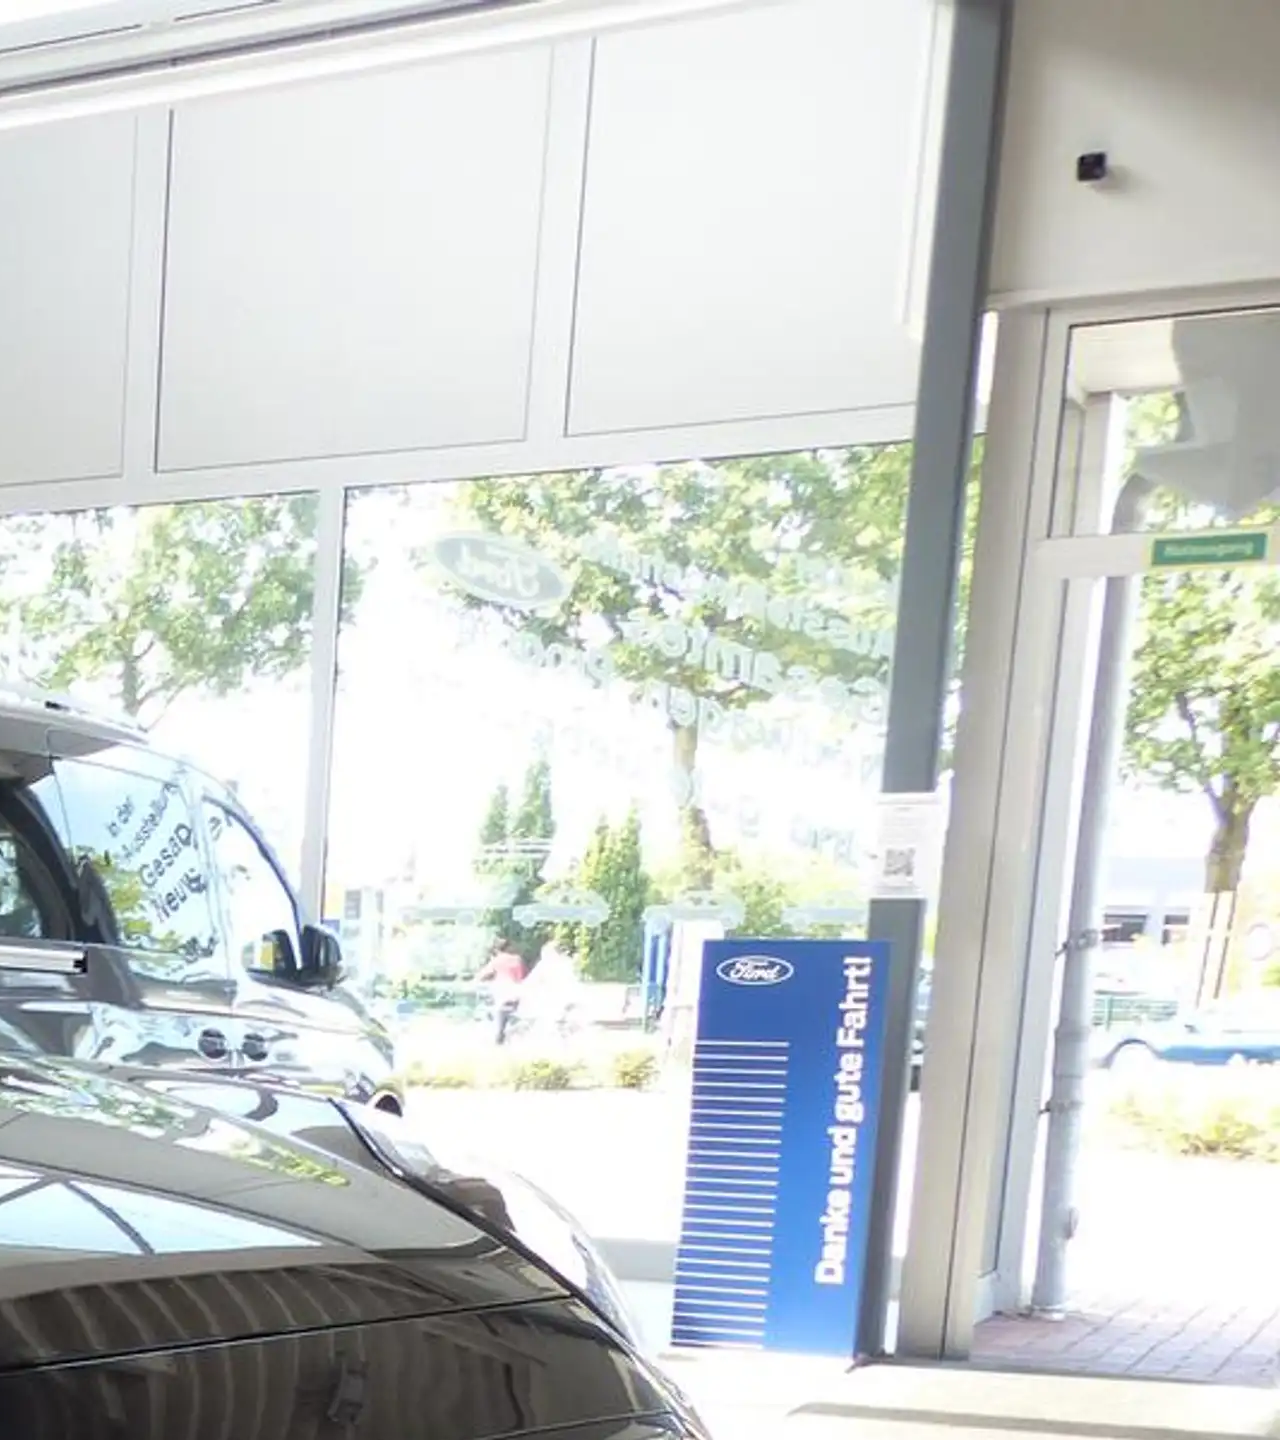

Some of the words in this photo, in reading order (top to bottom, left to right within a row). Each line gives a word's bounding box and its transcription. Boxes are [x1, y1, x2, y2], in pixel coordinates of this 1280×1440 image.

[729, 958, 782, 982] Ford
[835, 955, 873, 1048] Fahrt!
[833, 1052, 864, 1123] gute
[827, 1125, 857, 1185] und
[814, 1188, 852, 1285] Danke
